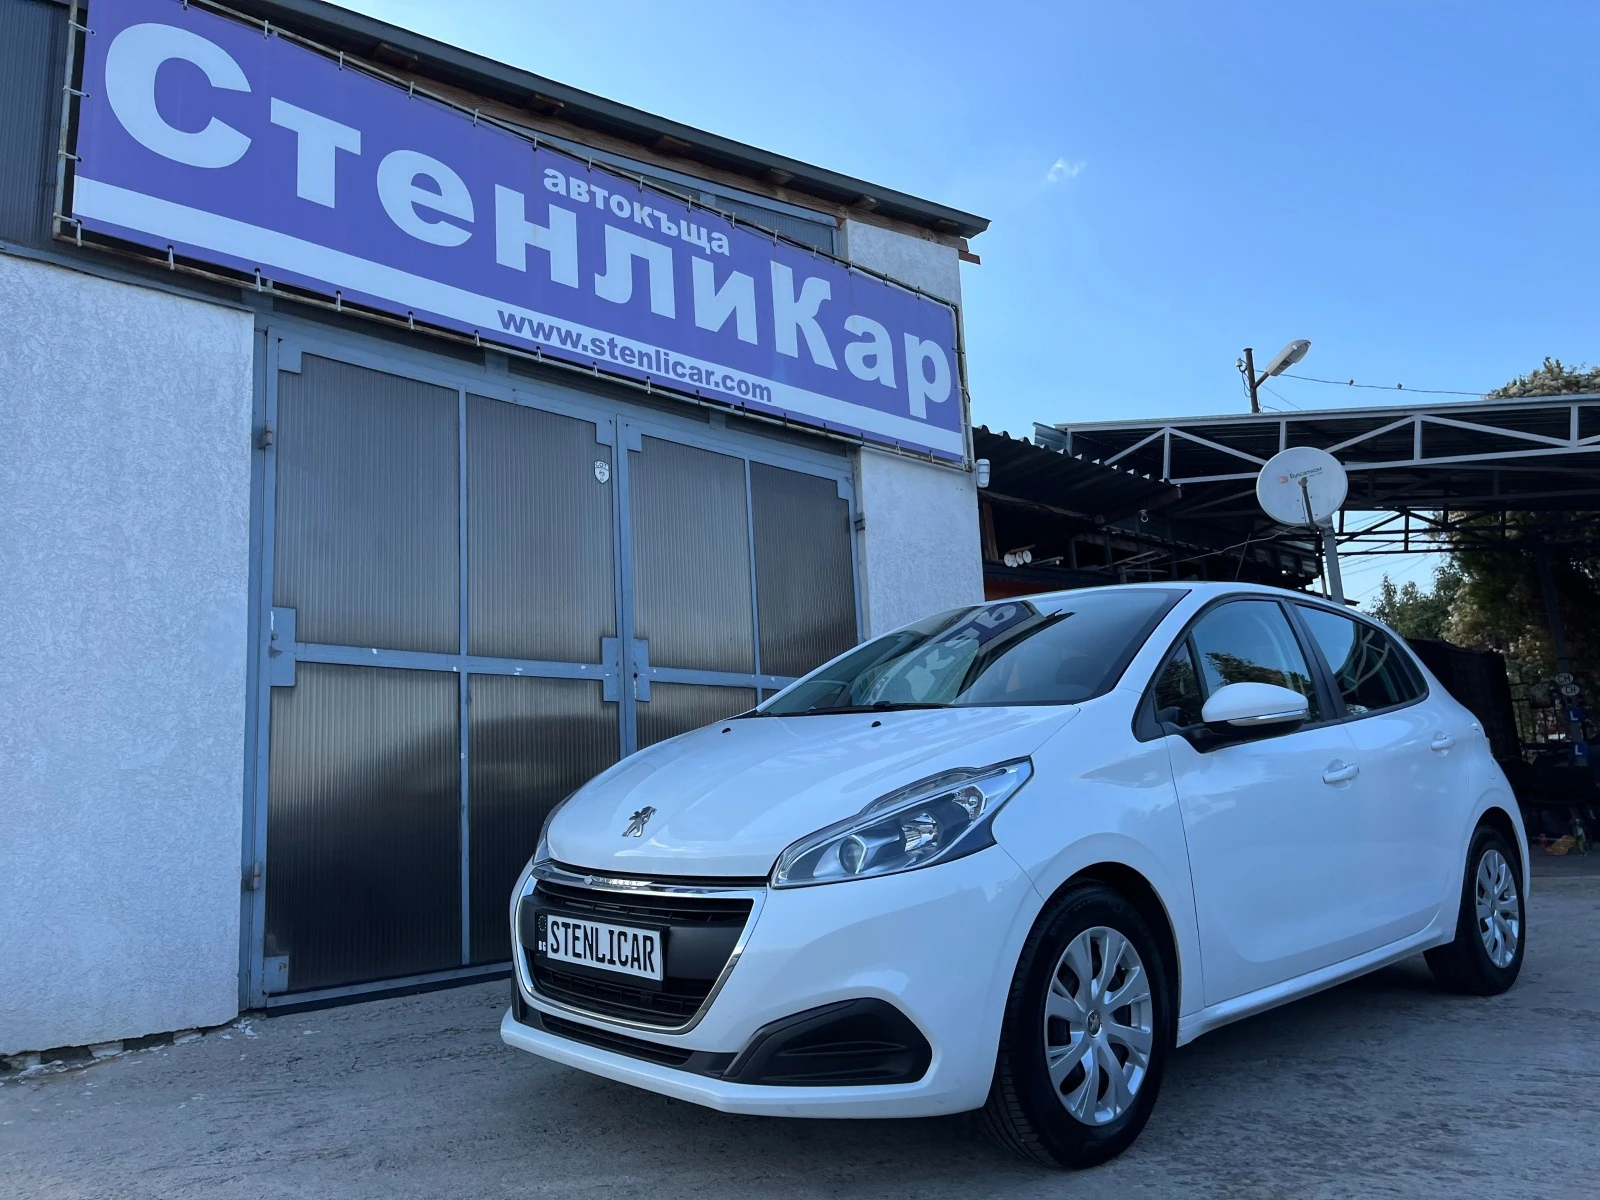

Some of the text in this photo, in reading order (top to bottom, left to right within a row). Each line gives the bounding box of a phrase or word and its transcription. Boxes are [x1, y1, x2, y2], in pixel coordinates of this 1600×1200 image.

[105, 22, 951, 419] СтенлиКар
[543, 168, 731, 256] автокъща
[497, 309, 772, 402] www.stenlicar.com
[1557, 675, 1571, 684] CH
[1565, 686, 1576, 694] CH
[538, 920, 655, 973] BG STENLICAR
